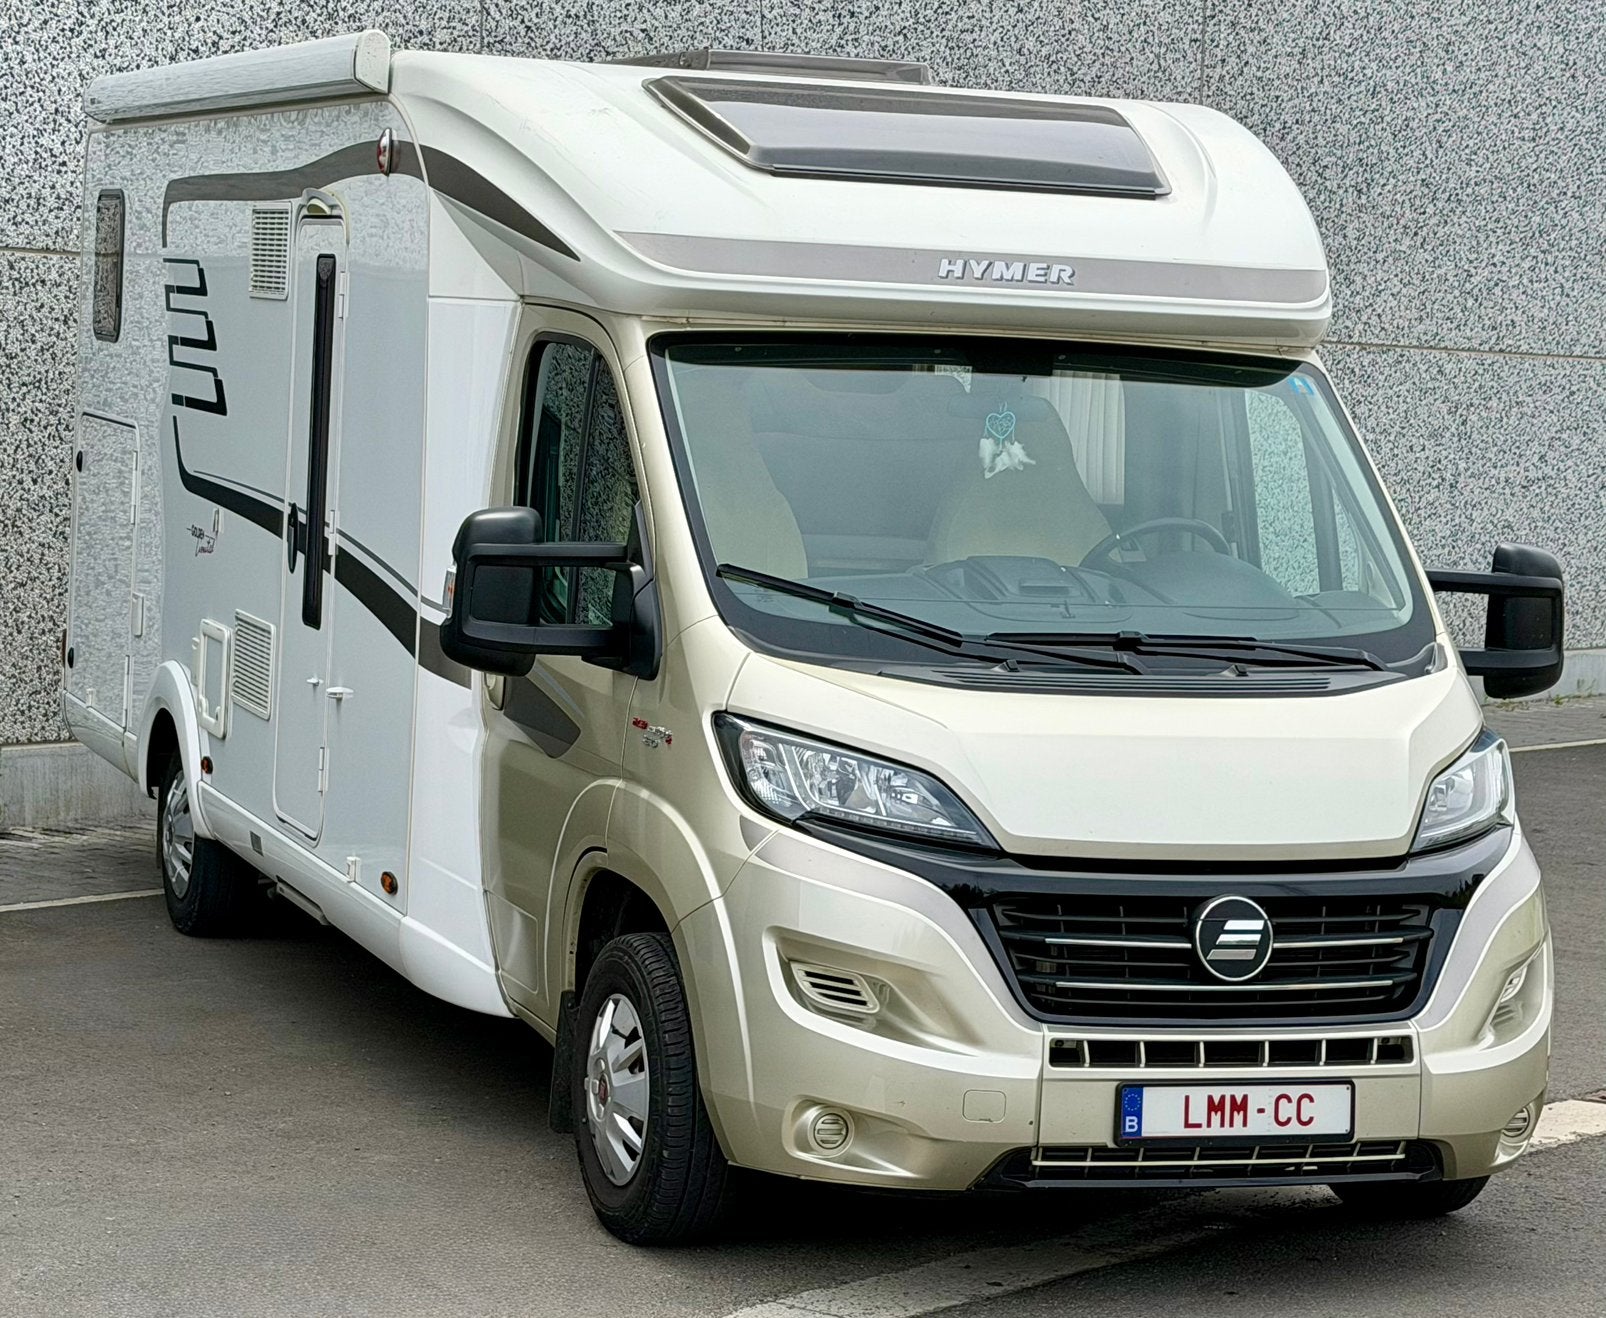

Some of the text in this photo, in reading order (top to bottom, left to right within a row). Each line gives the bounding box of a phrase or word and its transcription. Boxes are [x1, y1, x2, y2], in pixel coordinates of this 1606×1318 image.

[938, 258, 1075, 285] HYMER
[1125, 1116, 1138, 1133] B
[1183, 1093, 1315, 1129] LMM-CC
